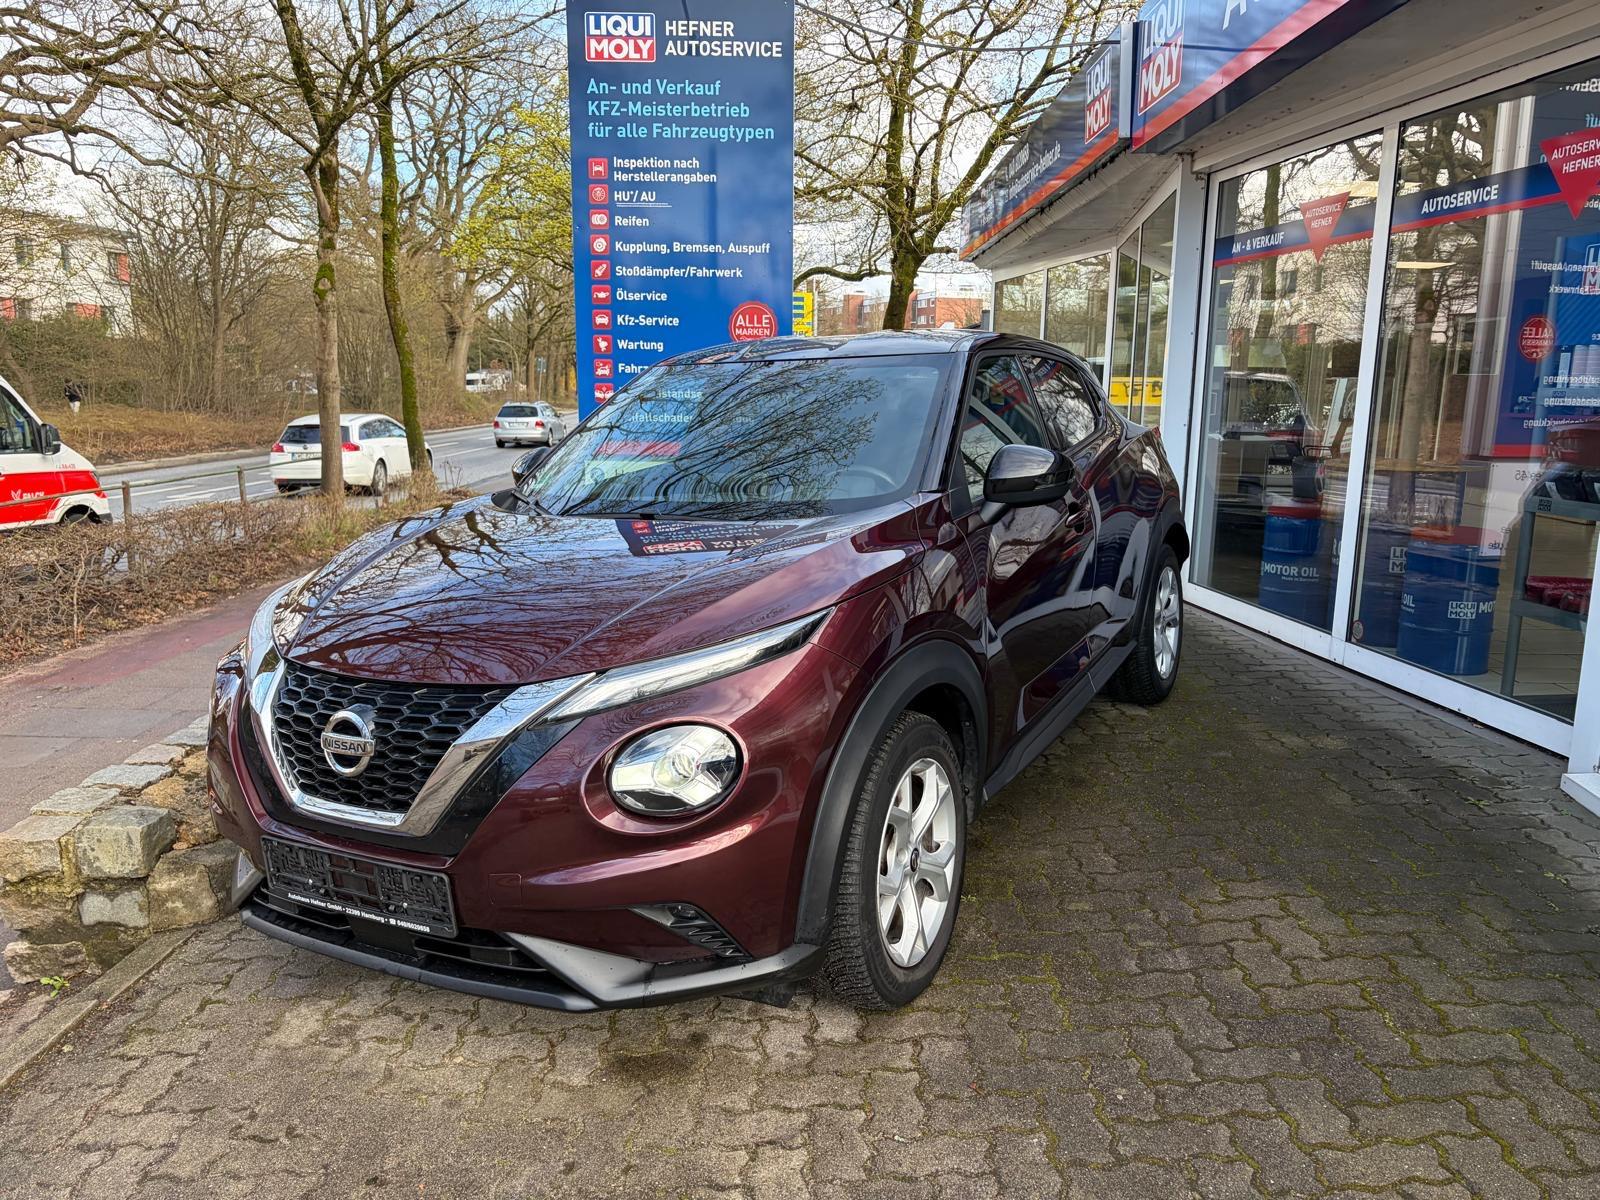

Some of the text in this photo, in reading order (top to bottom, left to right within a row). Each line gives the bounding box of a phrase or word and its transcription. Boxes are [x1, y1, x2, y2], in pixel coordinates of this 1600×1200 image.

[588, 15, 653, 38] LIQUI
[665, 20, 735, 38] HEFNER
[588, 38, 654, 60] MOLY
[664, 41, 783, 58] AUTOSERVICE
[1086, 53, 1110, 104] LIQUI
[1140, 36, 1183, 108] MOLY
[586, 78, 721, 96] An- und Verkauf
[588, 100, 750, 118] KFZ-Meisterbetrieb
[1085, 91, 1111, 140] MOLY
[587, 122, 775, 143] für alle Fahrzeugtypen
[613, 156, 700, 171] Inspektion nach
[613, 171, 717, 185] Herstellerangaben
[640, 191, 656, 202] AU
[1421, 184, 1499, 215] AUTOSERVICE
[1305, 202, 1342, 218] AUTOSERVICE
[614, 216, 650, 227] Reifen
[1311, 217, 1333, 229] HEFNER
[615, 241, 771, 255] Kupplung, Bremsen, Auspuff
[1252, 232, 1285, 249] VERKAUF
[615, 265, 743, 279] Stoßdämpfer/Fahrwerk
[616, 287, 668, 302] Ölservice
[617, 315, 680, 328] Kfz-Service
[735, 314, 771, 328] ALLE
[735, 327, 771, 337] MARKEN
[617, 339, 664, 352] Wartung
[1264, 562, 1320, 577] MOTOR OIL
[1450, 602, 1476, 610] LIQUI
[1449, 610, 1475, 618] MOLY
[324, 737, 366, 752] NISSAN
